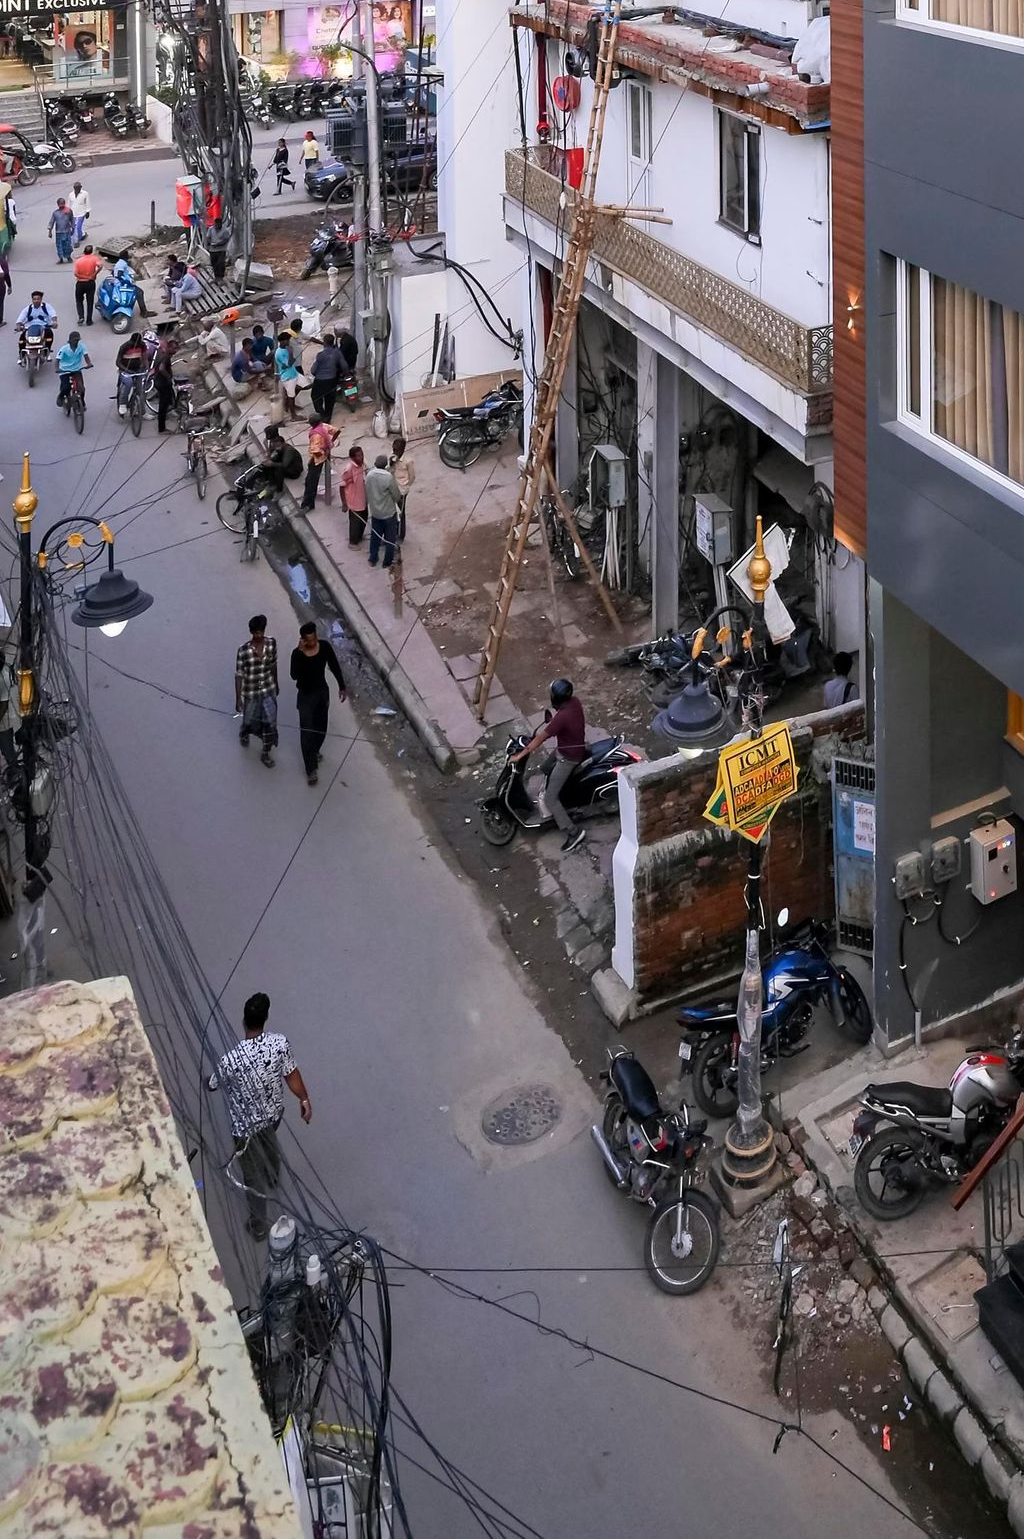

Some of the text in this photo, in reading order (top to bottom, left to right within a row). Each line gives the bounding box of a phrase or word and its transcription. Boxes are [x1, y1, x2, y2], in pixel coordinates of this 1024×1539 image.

[738, 738, 778, 770] ICMT
[734, 779, 754, 796] ADCA
[735, 788, 755, 806] DCA
[755, 779, 773, 796] DFA
